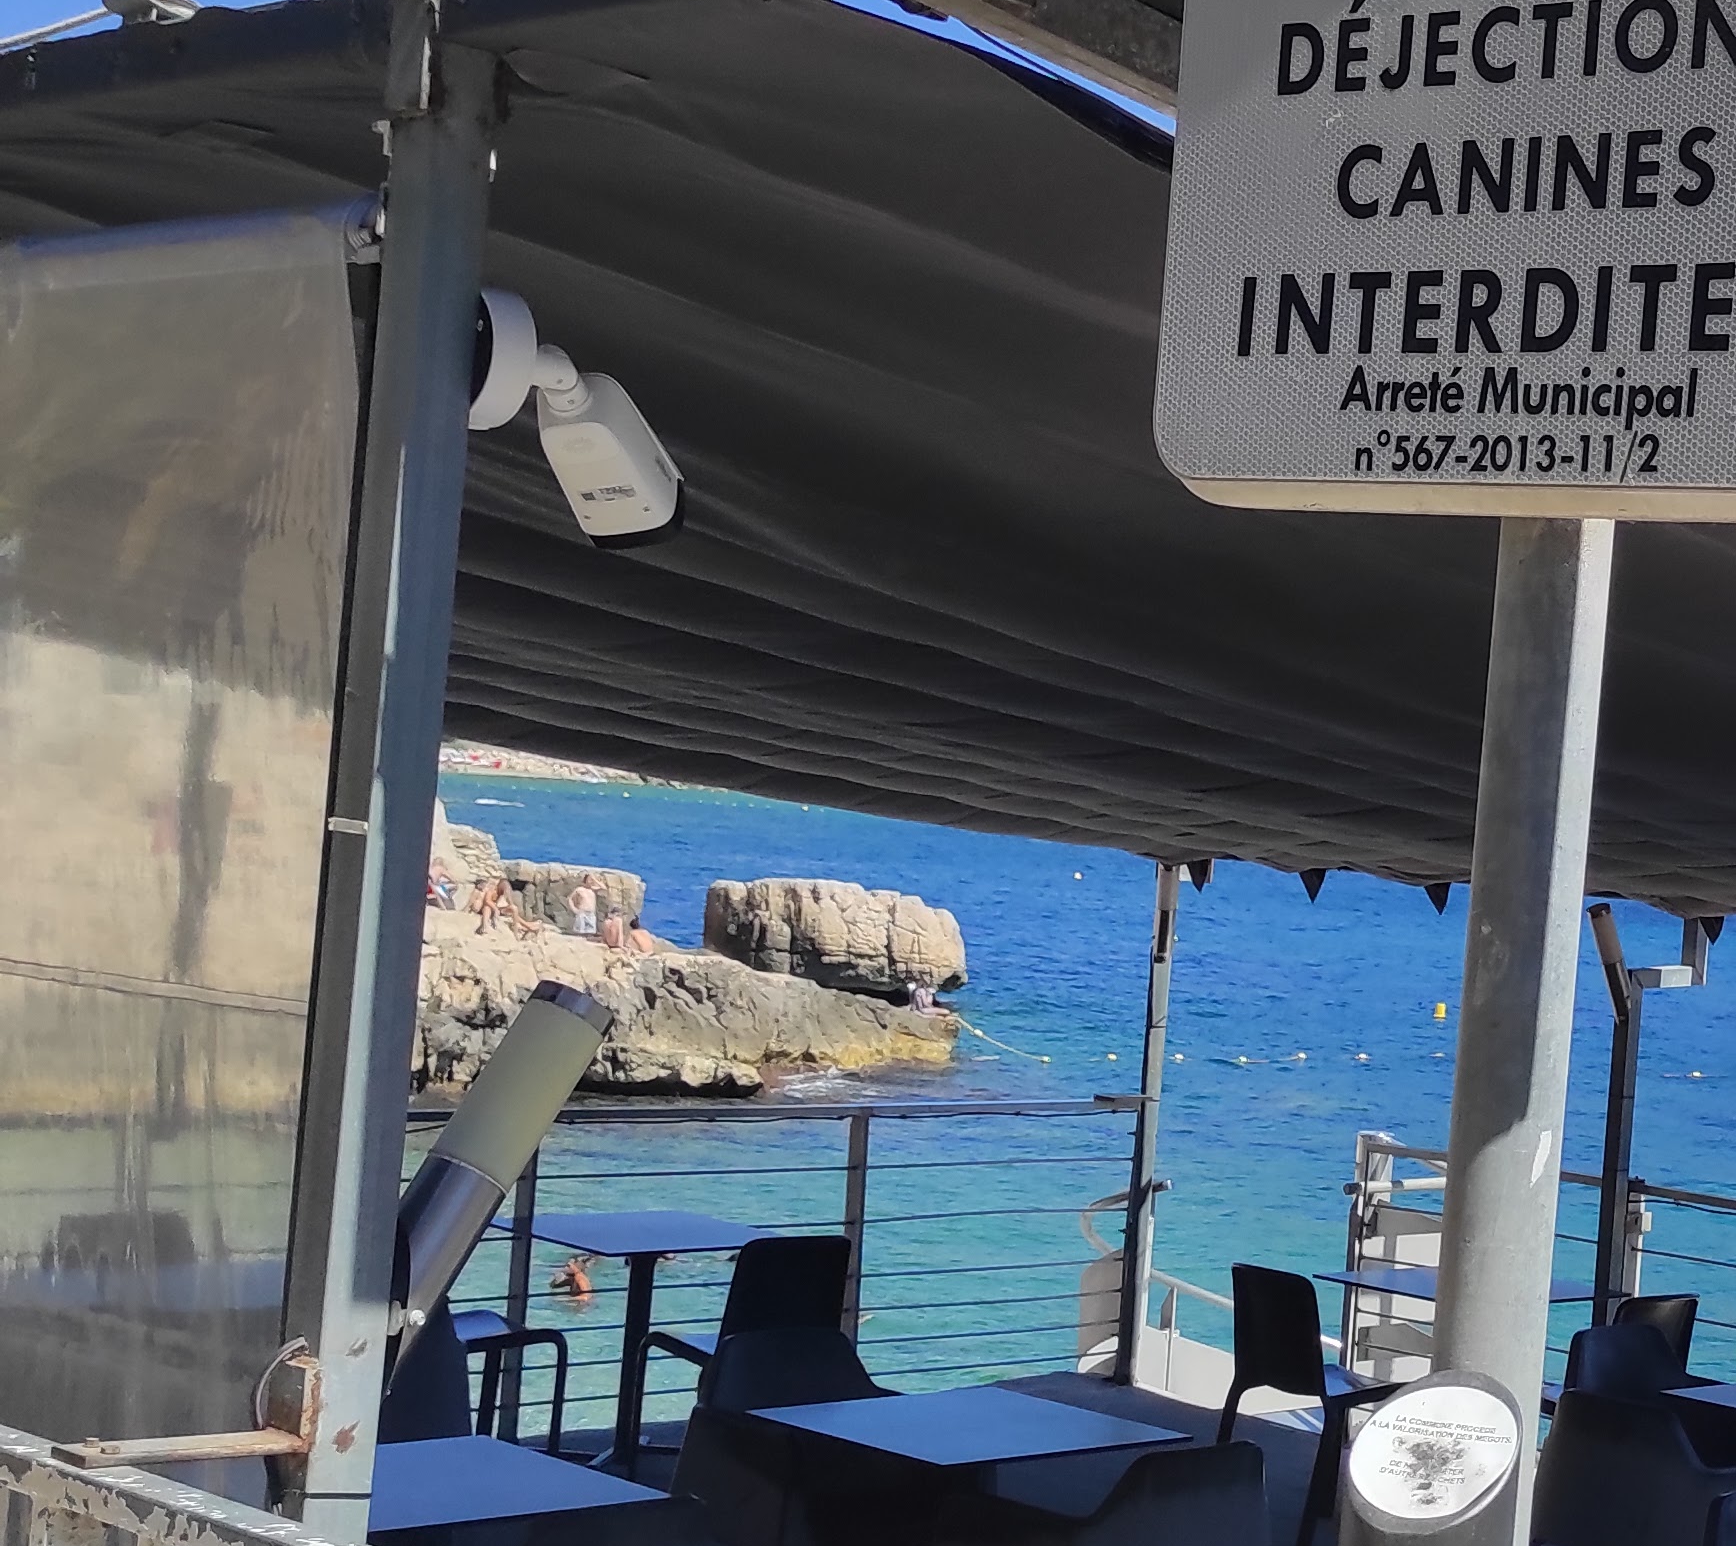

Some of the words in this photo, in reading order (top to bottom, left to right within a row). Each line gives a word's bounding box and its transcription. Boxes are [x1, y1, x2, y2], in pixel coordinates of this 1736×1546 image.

[1336, 126, 1718, 220] CANINES
[1339, 364, 1465, 415] Arreté
[1476, 365, 1699, 431] Municipal
